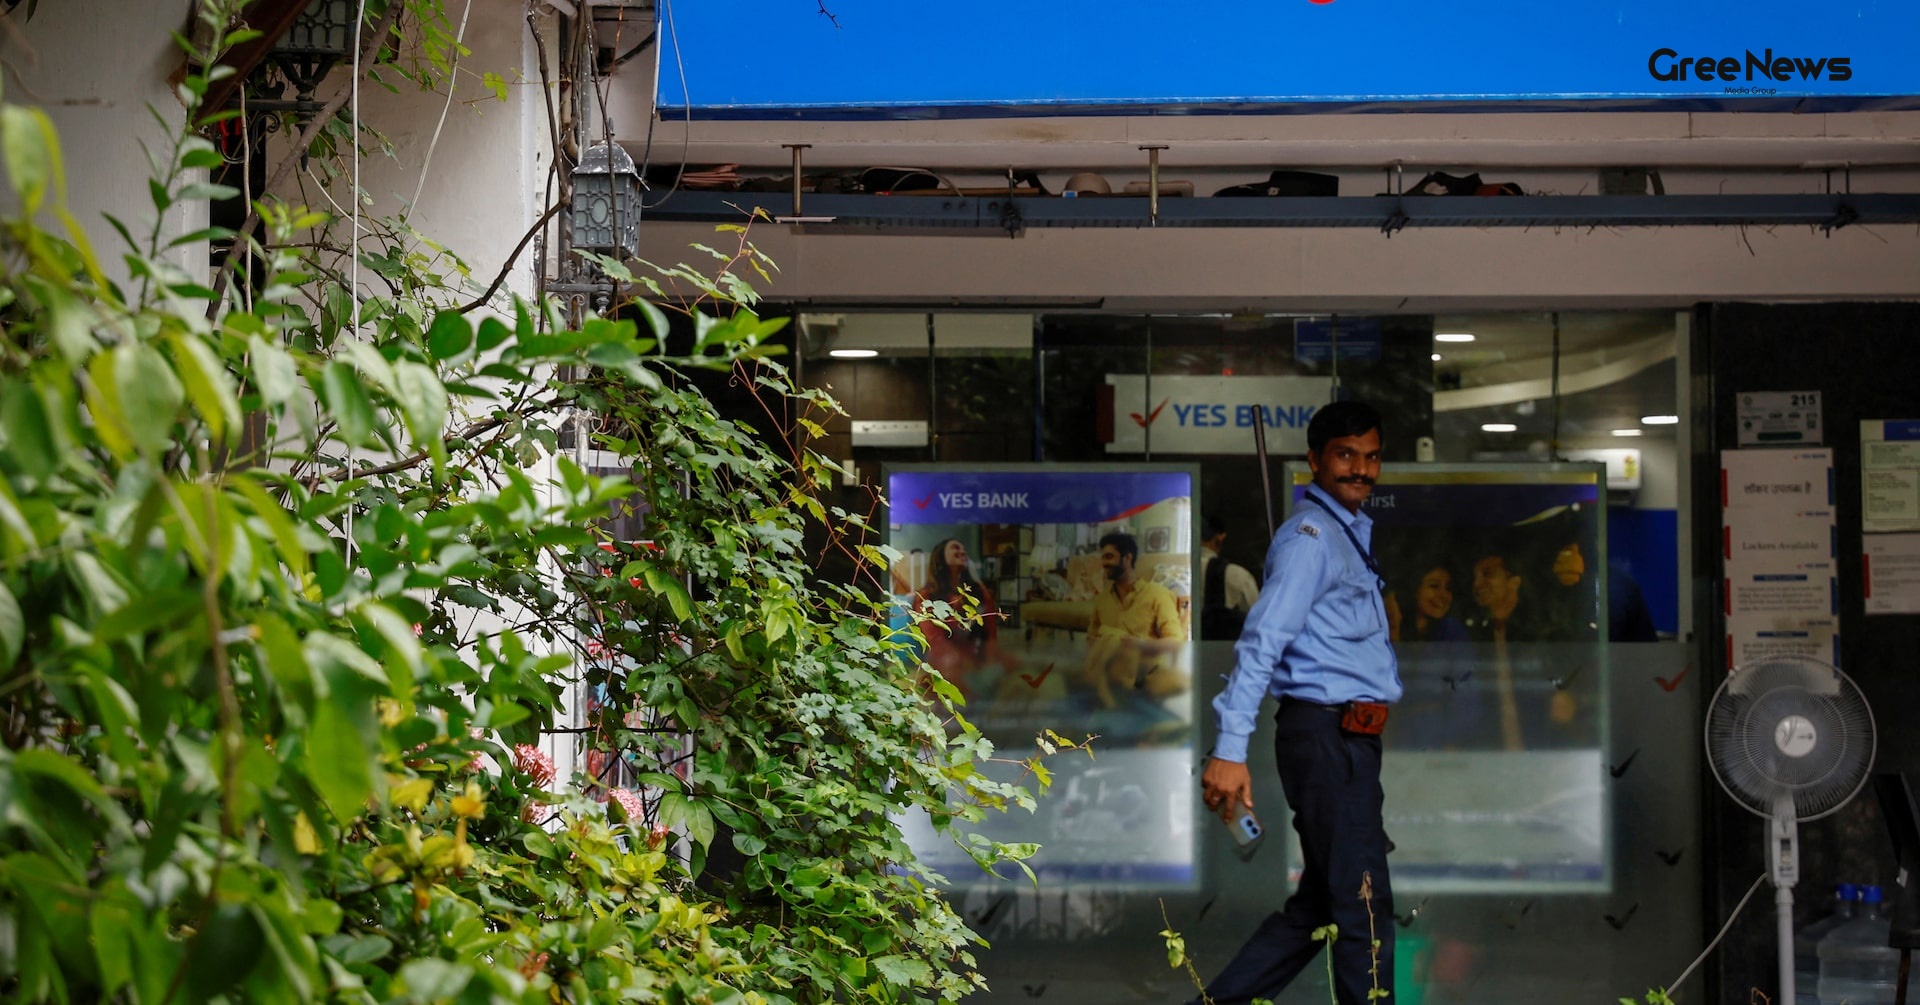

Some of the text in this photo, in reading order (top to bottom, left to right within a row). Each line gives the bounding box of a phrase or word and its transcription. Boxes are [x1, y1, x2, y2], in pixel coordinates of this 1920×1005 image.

[1791, 394, 1816, 406] 215
[1173, 404, 1316, 428] YES BANK
[939, 493, 1029, 508] YES BANK
